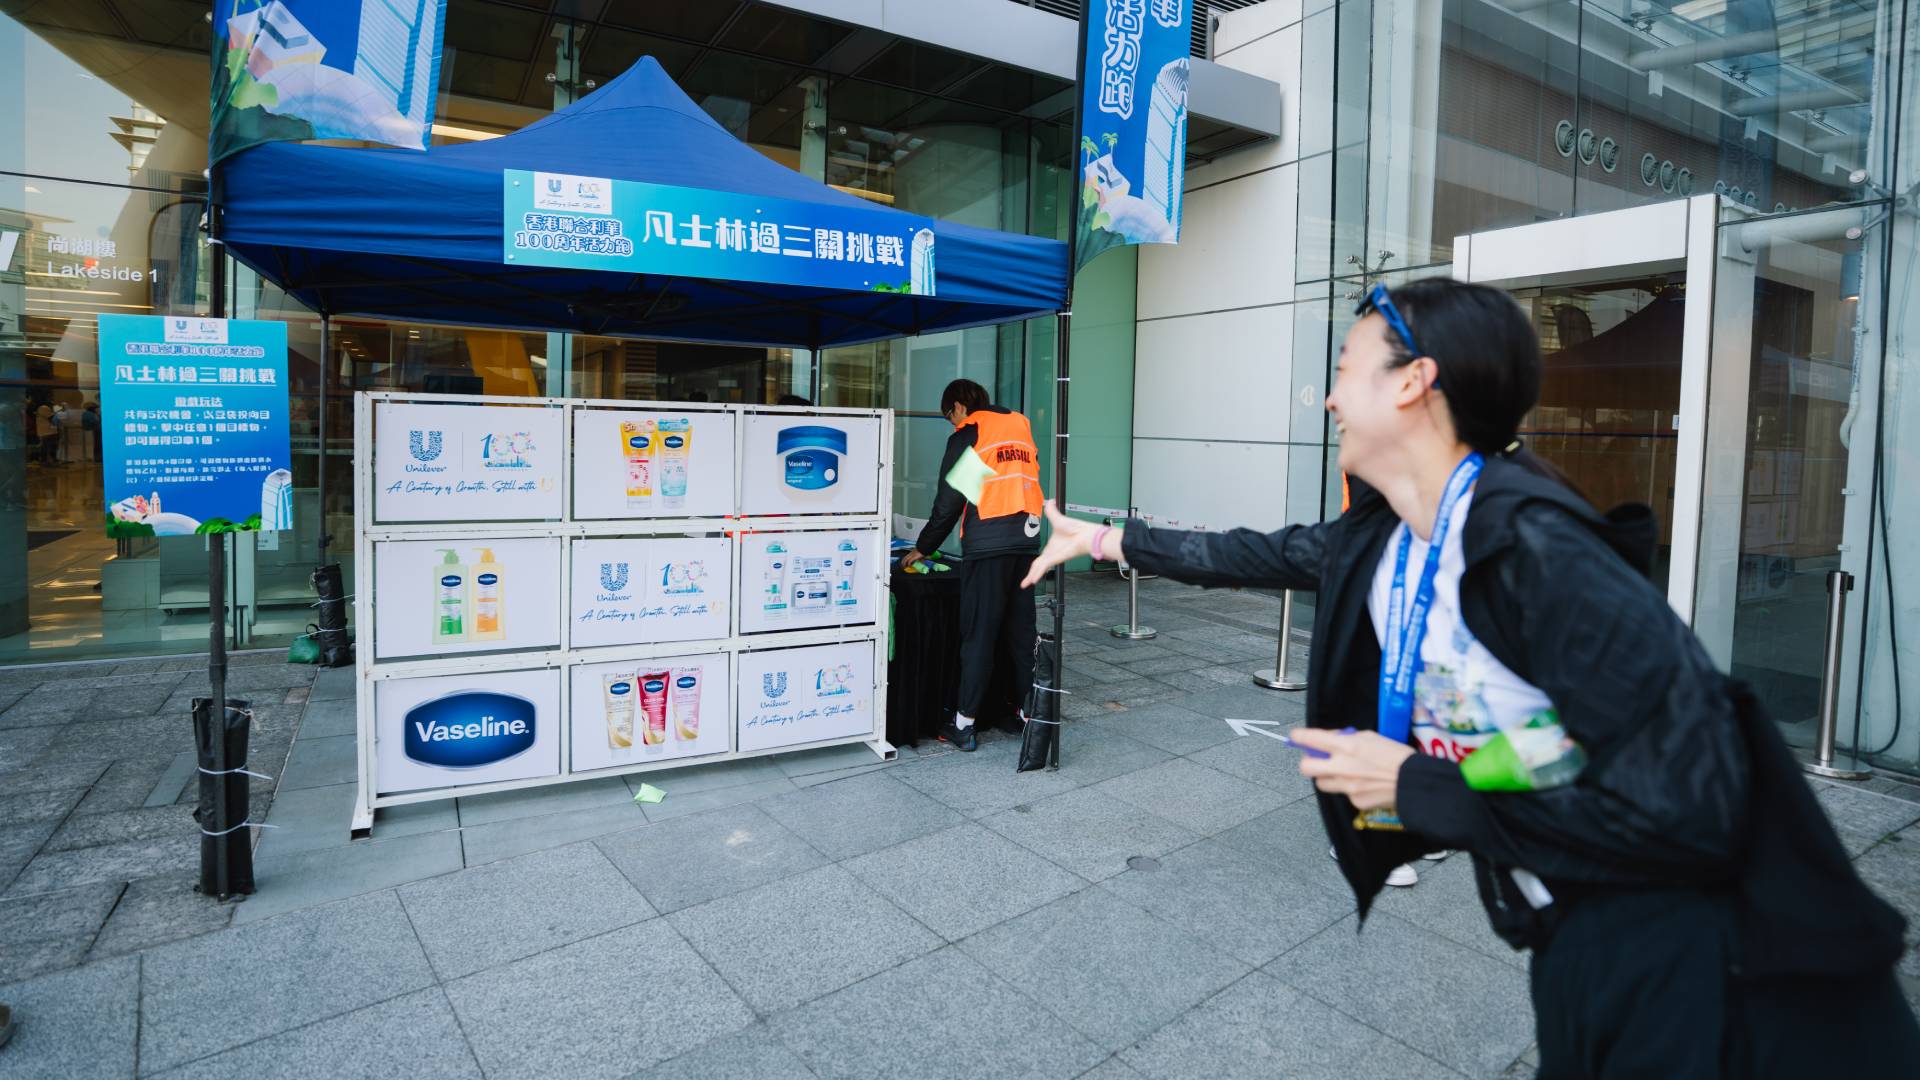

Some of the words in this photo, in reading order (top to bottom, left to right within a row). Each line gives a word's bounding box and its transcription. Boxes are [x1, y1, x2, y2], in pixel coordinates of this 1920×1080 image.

[524, 213, 621, 237] 香港聯合利華
[514, 232, 633, 256] 100周年活力跑
[642, 210, 905, 266] 凡士林過三關挑戰
[47, 261, 143, 282] Lakeside
[149, 269, 158, 283] 1
[114, 365, 276, 383] 凡士林過三關挑戰
[997, 448, 1031, 464] MARSHL
[405, 464, 447, 473] Unilever
[386, 480, 402, 495] A
[405, 480, 442, 496] Century
[492, 480, 516, 493] Still
[597, 593, 632, 601] Unilever
[760, 700, 790, 709] Unilever
[415, 716, 530, 742] Vaseline.
